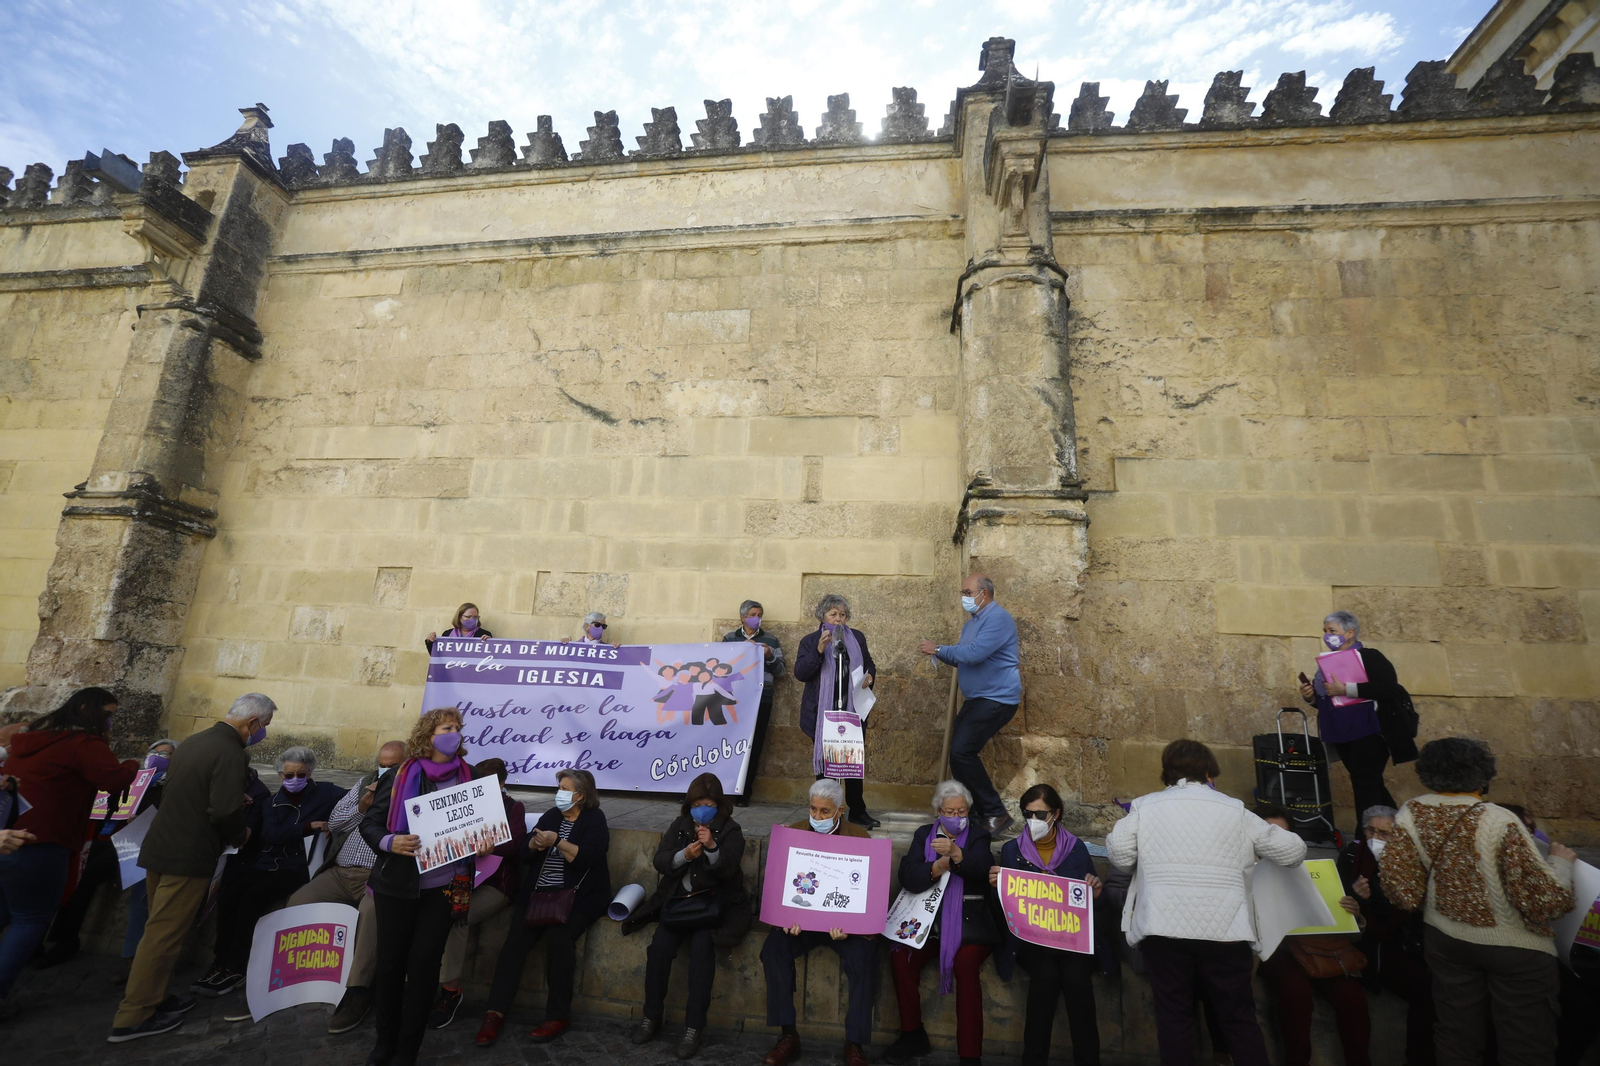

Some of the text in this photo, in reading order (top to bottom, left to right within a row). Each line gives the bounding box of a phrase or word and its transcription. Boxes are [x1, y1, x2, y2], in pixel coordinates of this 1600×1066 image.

[437, 641, 619, 660] REVUELTA DE MUJERES
[445, 655, 507, 672] en la
[517, 669, 605, 686] IGLESIA
[455, 695, 635, 719] Hasta que la
[561, 728, 596, 745] se
[600, 718, 677, 748] haga
[650, 738, 749, 781] Córdoba
[429, 785, 484, 811] VENIMOS DE
[446, 804, 475, 823] LEJOS
[1007, 874, 1063, 903] DIGNIDAD
[1018, 899, 1081, 934] E IGUALDAD
[278, 928, 330, 954] DIGNIDAD
[287, 949, 340, 970] E IGUALDAD
